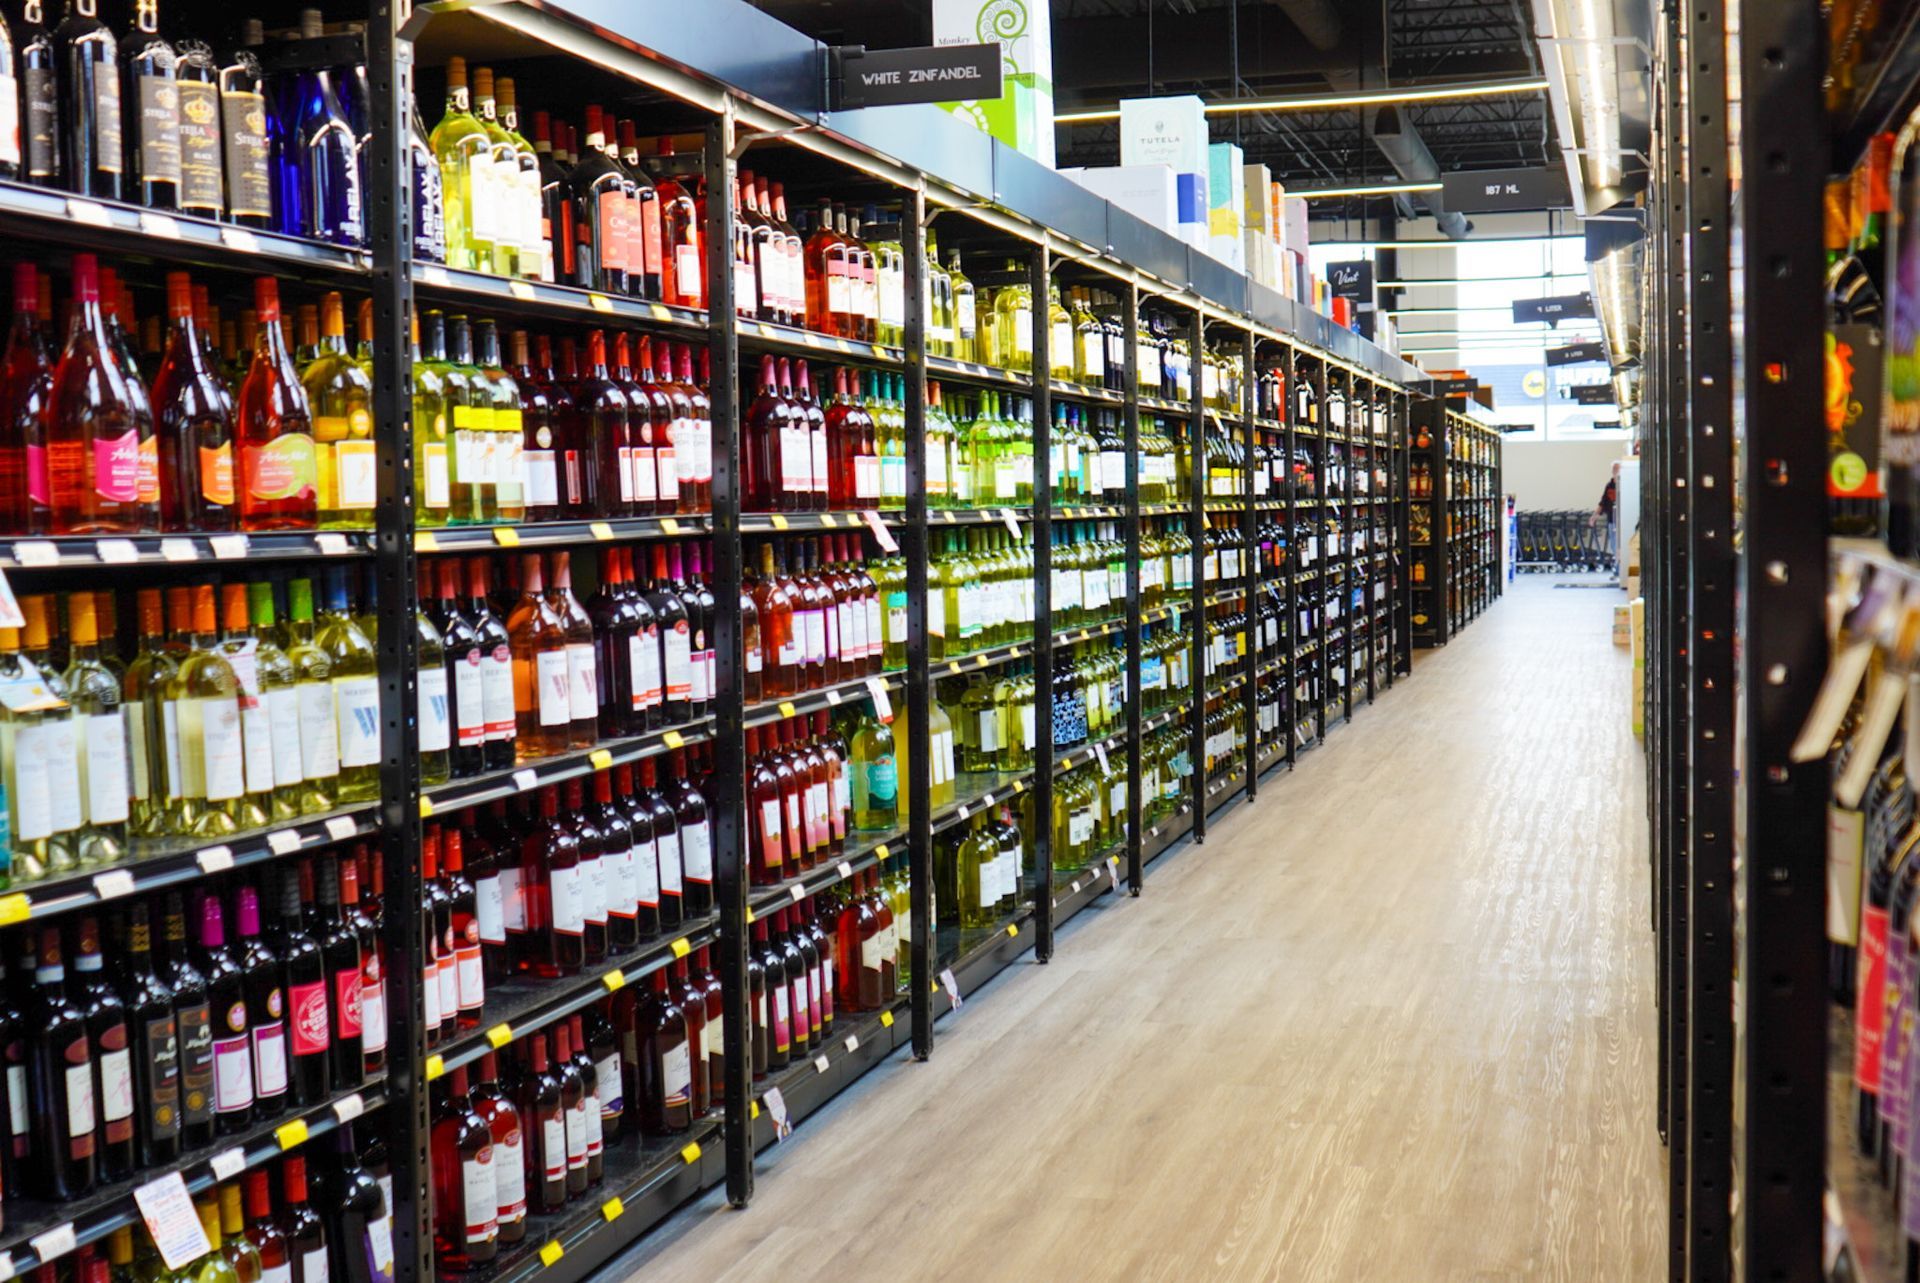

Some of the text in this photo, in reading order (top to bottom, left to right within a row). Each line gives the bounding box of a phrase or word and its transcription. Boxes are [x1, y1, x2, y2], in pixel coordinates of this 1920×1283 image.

[938, 36, 970, 45] Monkey
[862, 66, 981, 85] WHITE ZINFANDEL
[1140, 137, 1180, 145] TUTELA
[345, 154, 360, 224] RELAX
[1485, 184, 1519, 195] 187 ML
[421, 173, 434, 237] RELAX
[1334, 268, 1359, 285] Vint
